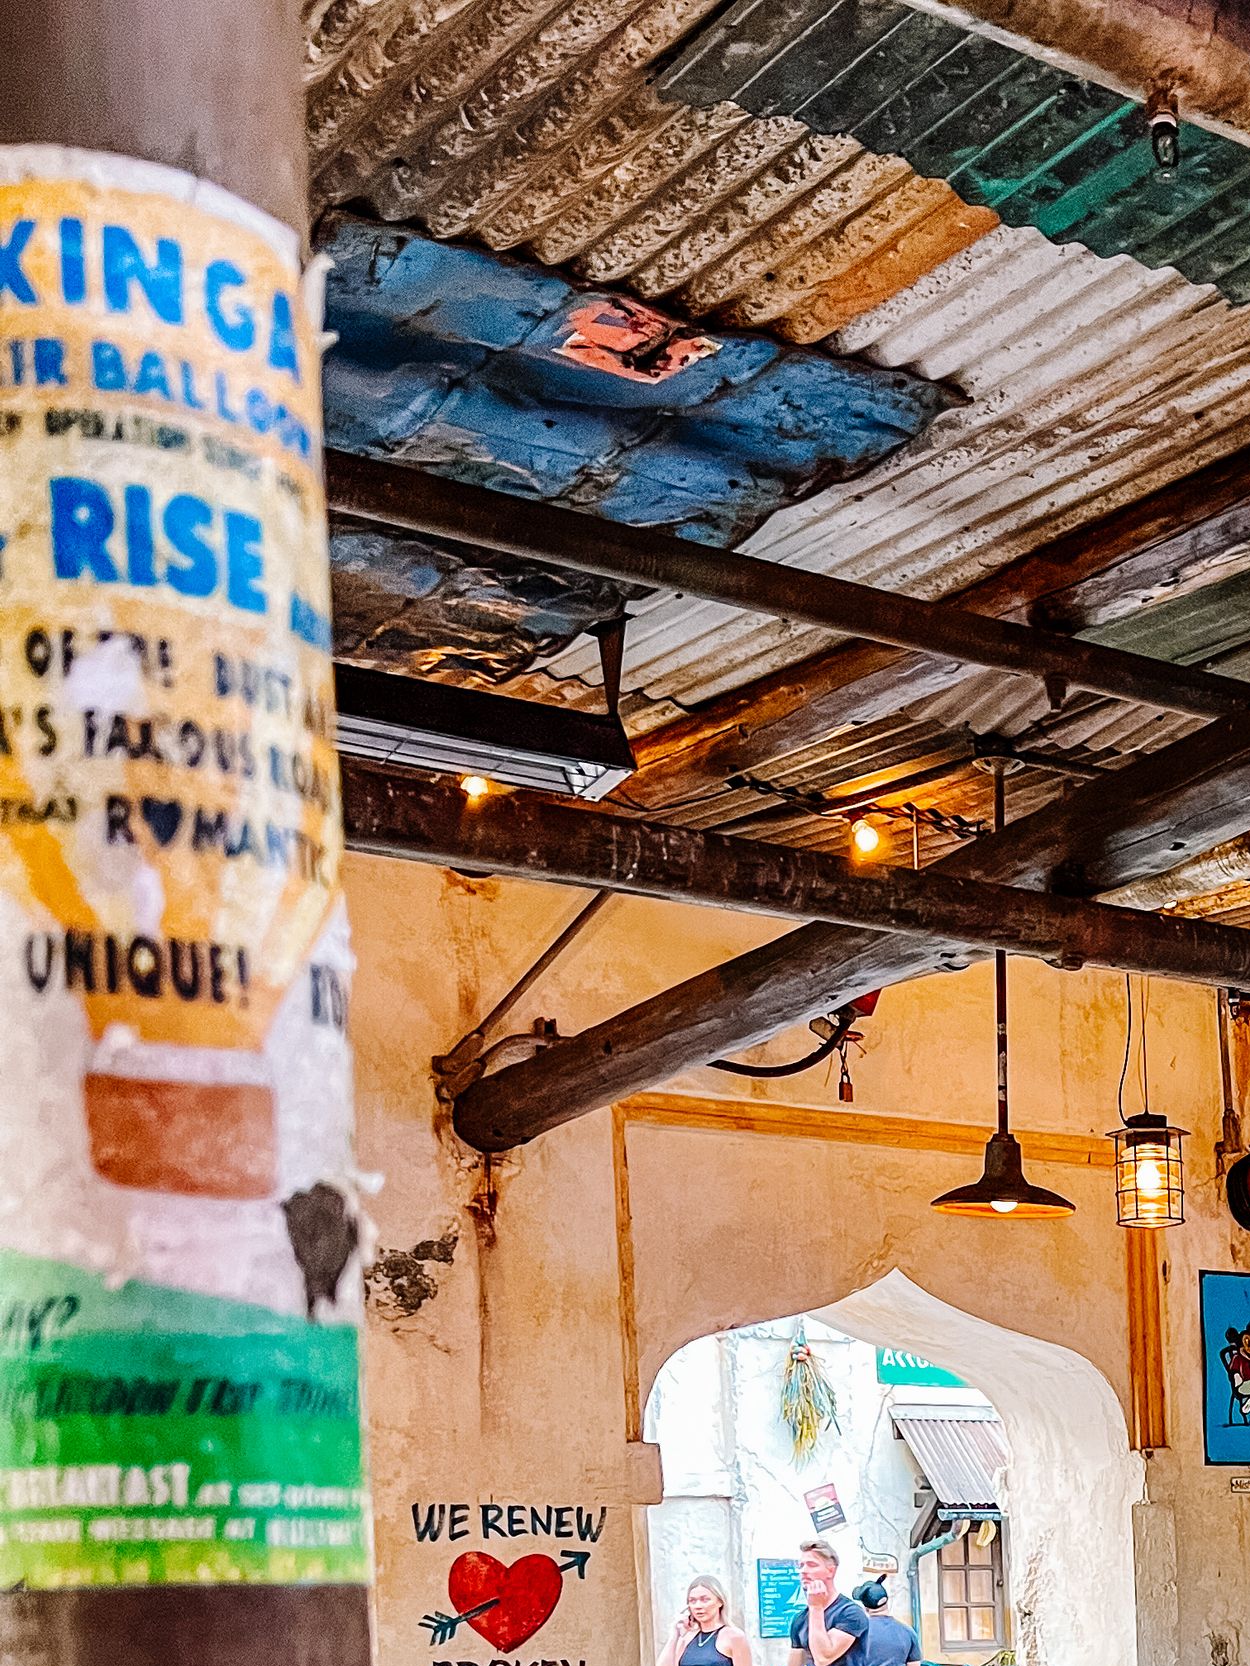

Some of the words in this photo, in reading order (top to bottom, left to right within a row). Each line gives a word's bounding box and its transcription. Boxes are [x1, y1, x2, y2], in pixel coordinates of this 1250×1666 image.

[50, 474, 268, 613] RISE
[26, 926, 250, 1010] UNIQUE!
[411, 1502, 471, 1543] WE
[479, 1504, 608, 1543] RENEW
